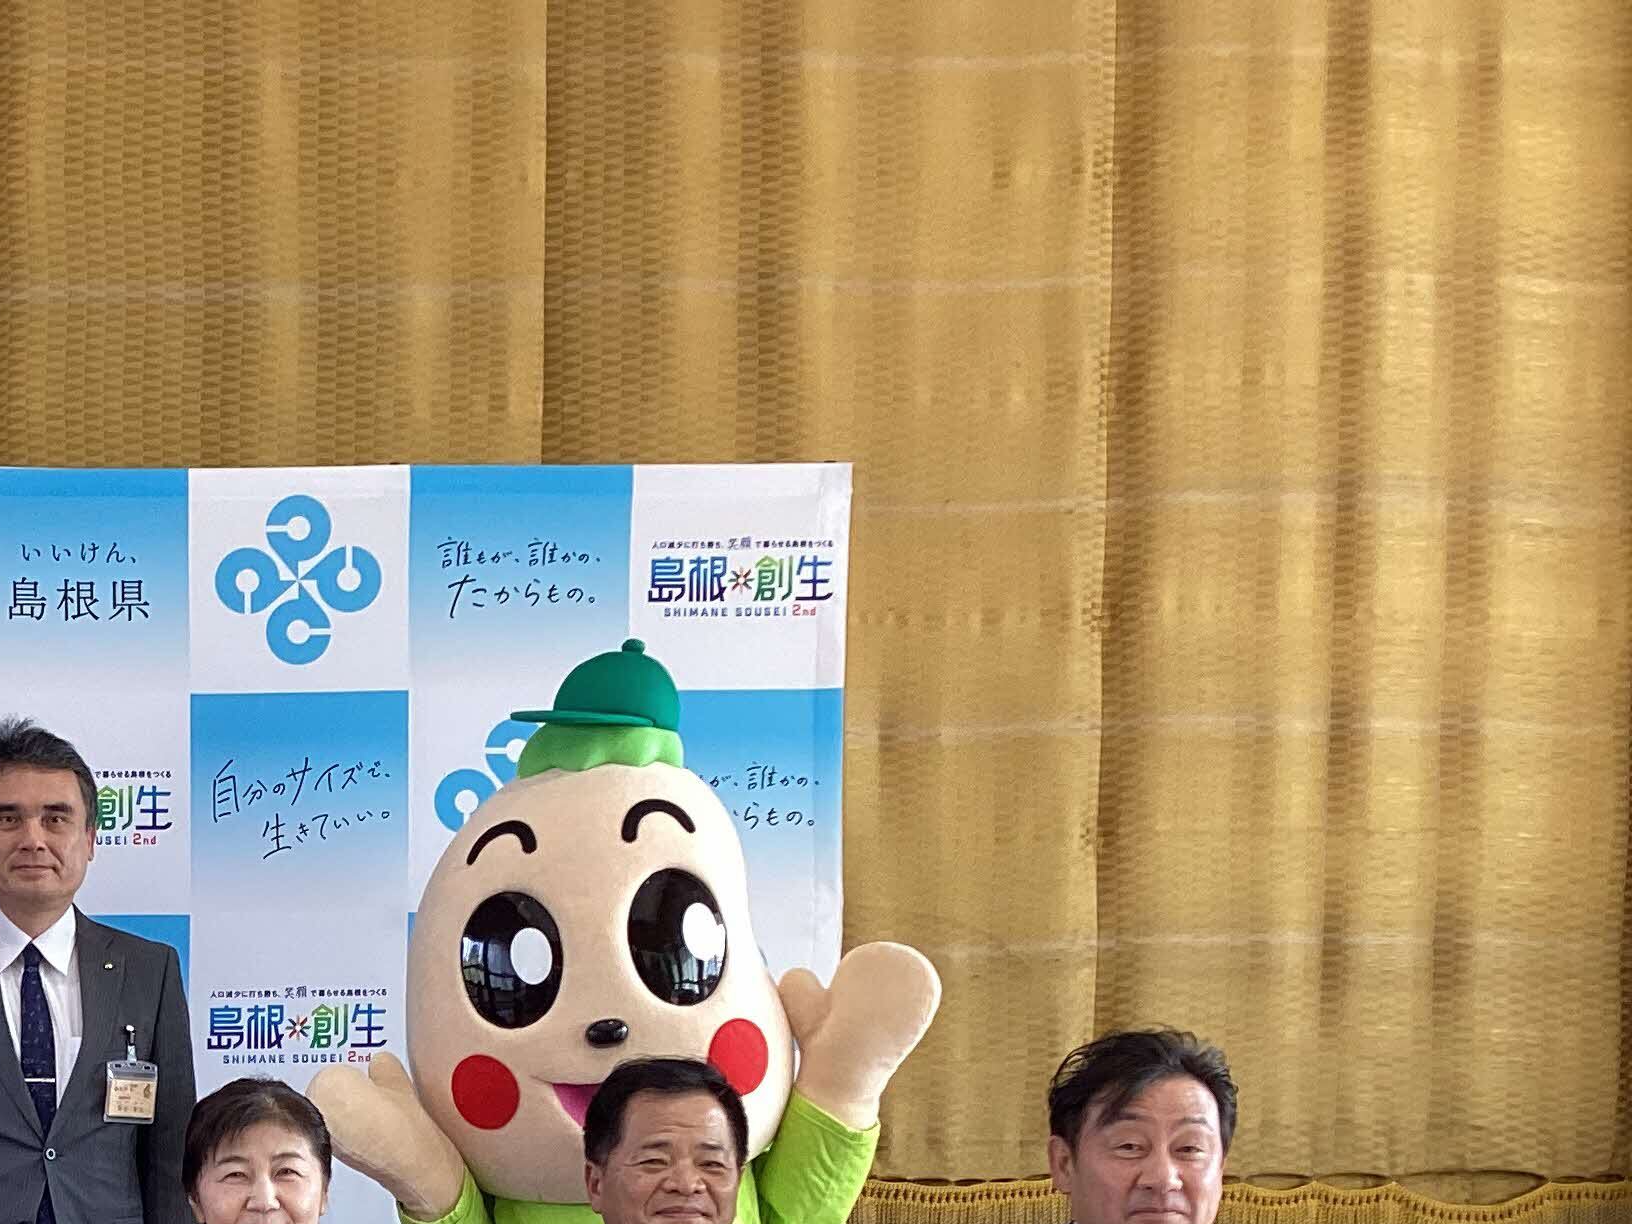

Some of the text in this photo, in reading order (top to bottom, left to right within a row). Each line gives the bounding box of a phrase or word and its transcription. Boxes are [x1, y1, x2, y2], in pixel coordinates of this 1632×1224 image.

[21, 542, 136, 564] いいけん、
[9, 577, 149, 621] 島根県
[448, 574, 595, 619] たからもの。
[664, 604, 816, 617] SHIMANE SOUSEI 2nd
[213, 757, 390, 823] 自分のサイズで、
[733, 802, 815, 830] らもの。
[133, 833, 156, 845] 2nd
[262, 810, 390, 859] 生きていい。
[223, 1051, 371, 1064] SHIMANE SOUSEI 2nd
